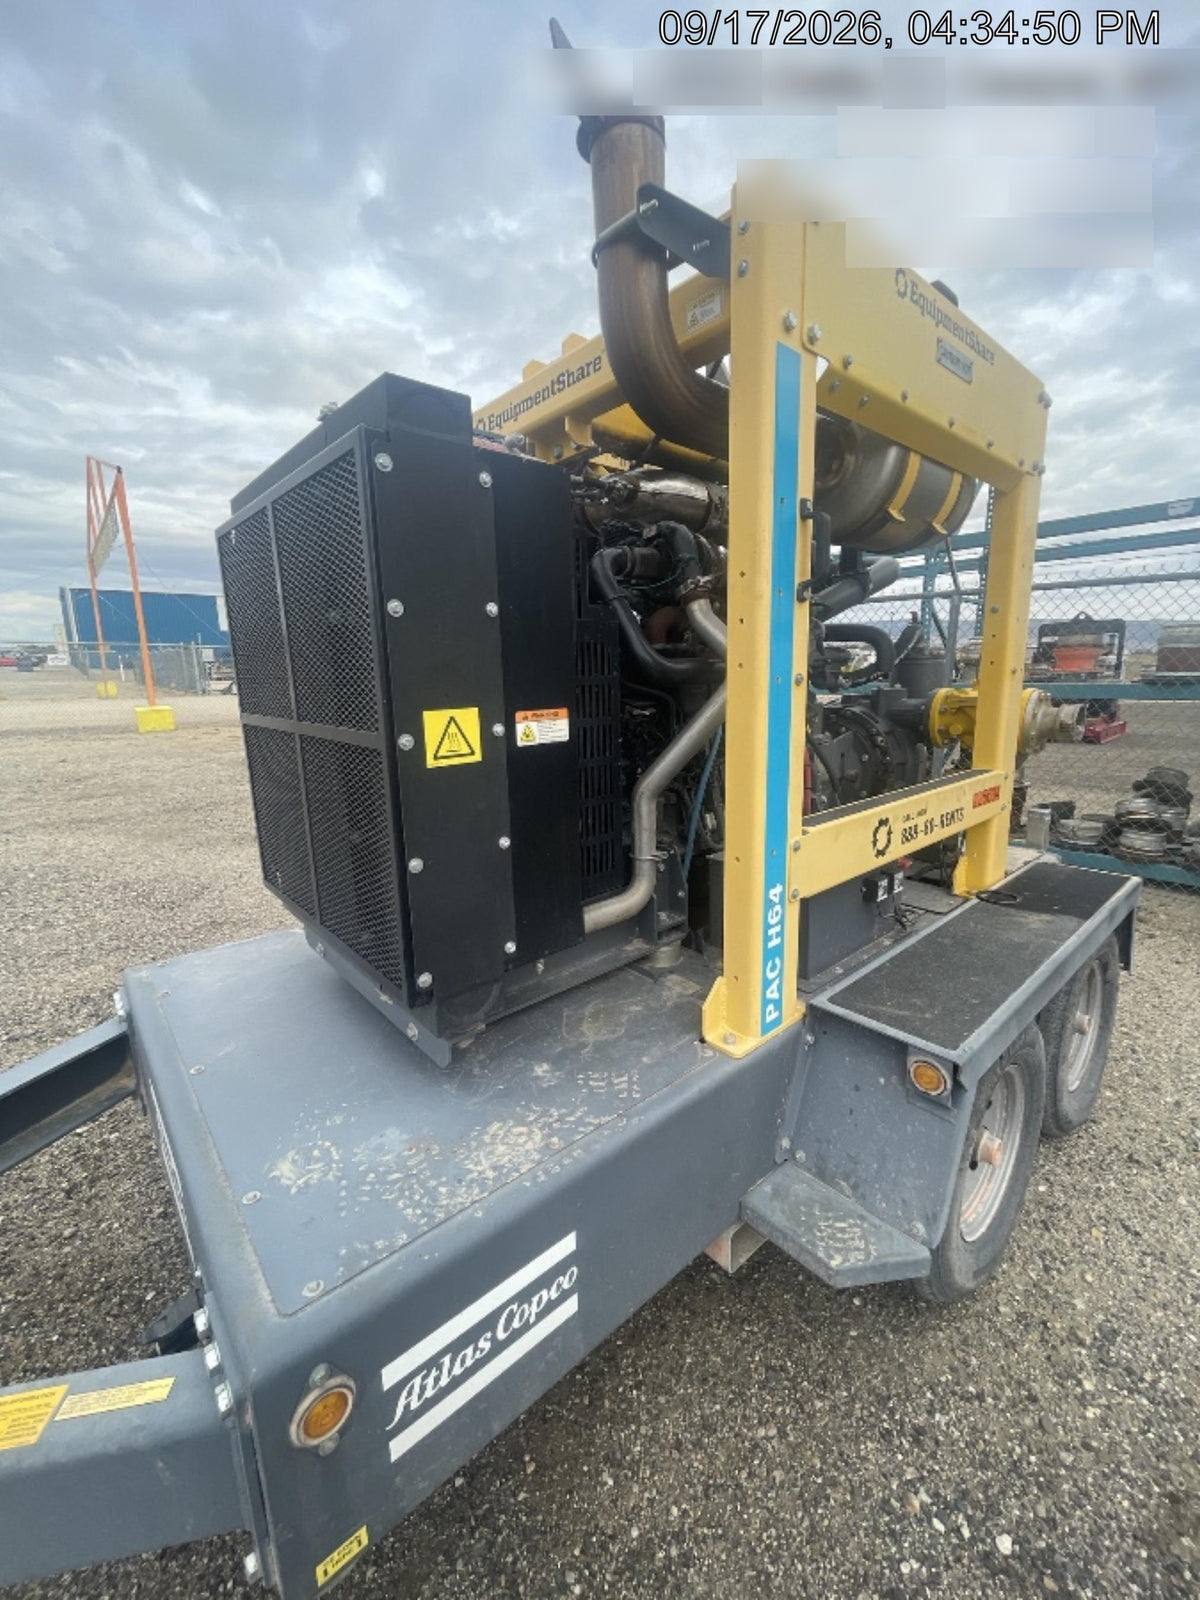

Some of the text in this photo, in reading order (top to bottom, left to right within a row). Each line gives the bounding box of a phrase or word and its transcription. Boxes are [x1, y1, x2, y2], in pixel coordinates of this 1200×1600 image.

[910, 279, 995, 366] EquipmentShare
[488, 355, 602, 432] EquipmentShare
[765, 882, 783, 1024] PAC H64
[384, 1265, 579, 1431] Atlas Copco
